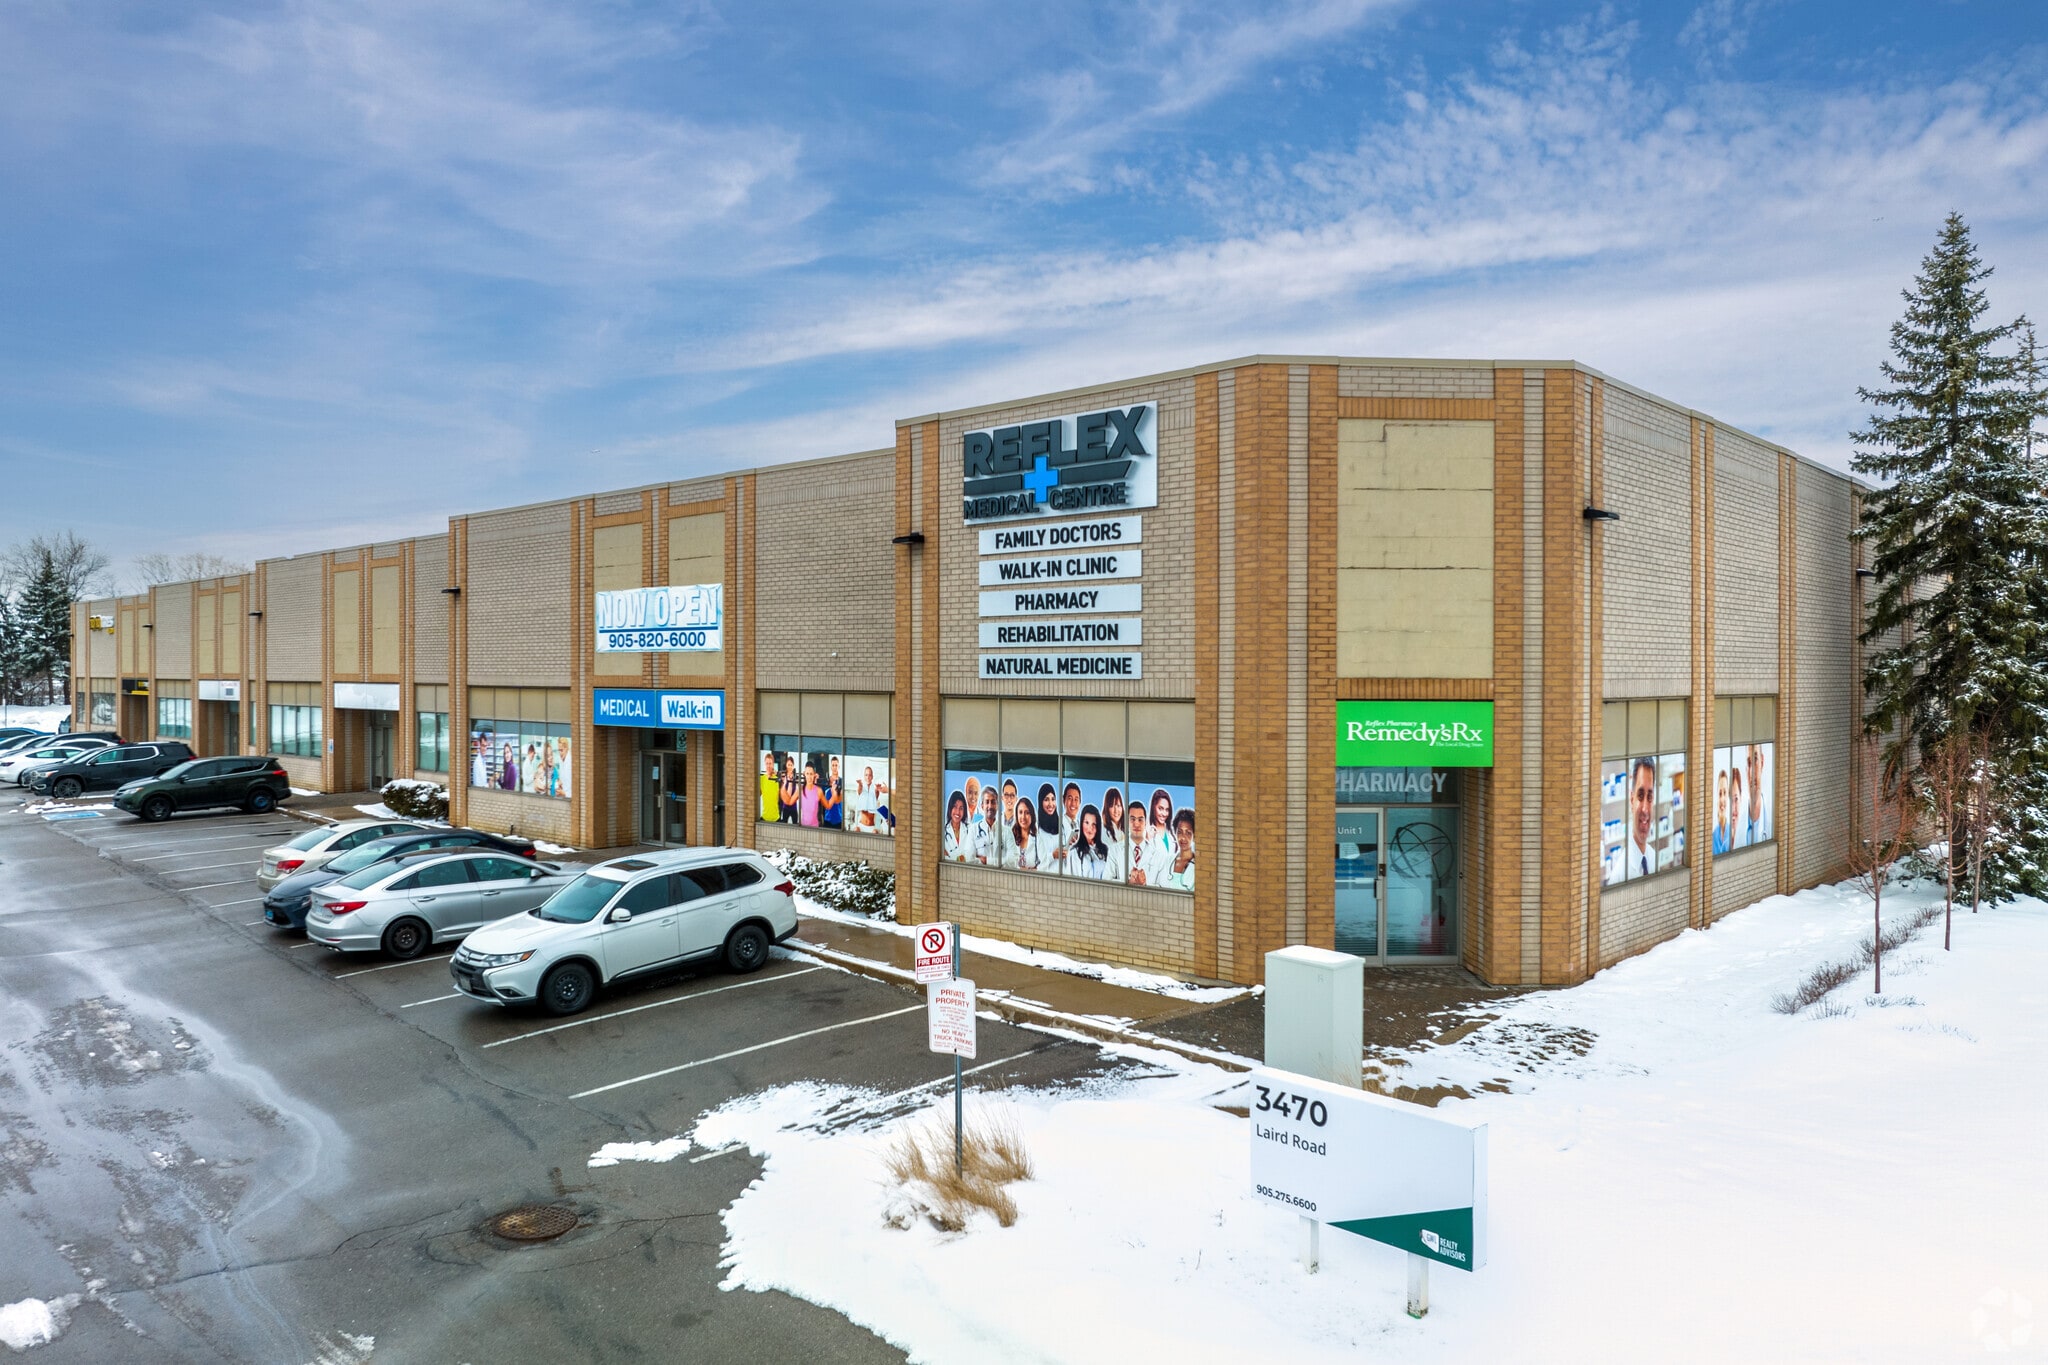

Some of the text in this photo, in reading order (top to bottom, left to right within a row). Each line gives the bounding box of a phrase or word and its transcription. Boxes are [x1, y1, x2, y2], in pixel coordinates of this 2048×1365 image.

[963, 405, 1150, 477] REFLEX
[963, 482, 1127, 519] MEDICAL CENTRE
[995, 522, 1122, 549] FAMILY DOCTORS
[999, 556, 1118, 580] WALK-IN CLINIC
[599, 588, 719, 628] NOW OPEN
[1015, 591, 1099, 611] PHARMACY
[608, 632, 706, 648] 905-820-6000
[997, 623, 1119, 643] REHABILITATION
[986, 657, 1132, 675] NATURAL MEDICINE
[599, 699, 713, 719] MEDICAL Walk-in
[1365, 720, 1417, 728] Reflex Pharmacy
[1337, 826, 1363, 835] Unit 1
[918, 956, 950, 966] FIRE ROUTE
[935, 997, 970, 1008] PROPERTY
[940, 989, 966, 999] PRIVATE
[1255, 1085, 1328, 1127] 3470
[1256, 1124, 1327, 1156] Laird Road
[1256, 1184, 1317, 1212] 905.275.6600
[1439, 1237, 1458, 1250] REALTY
[1439, 1246, 1466, 1262] ADVISORS
